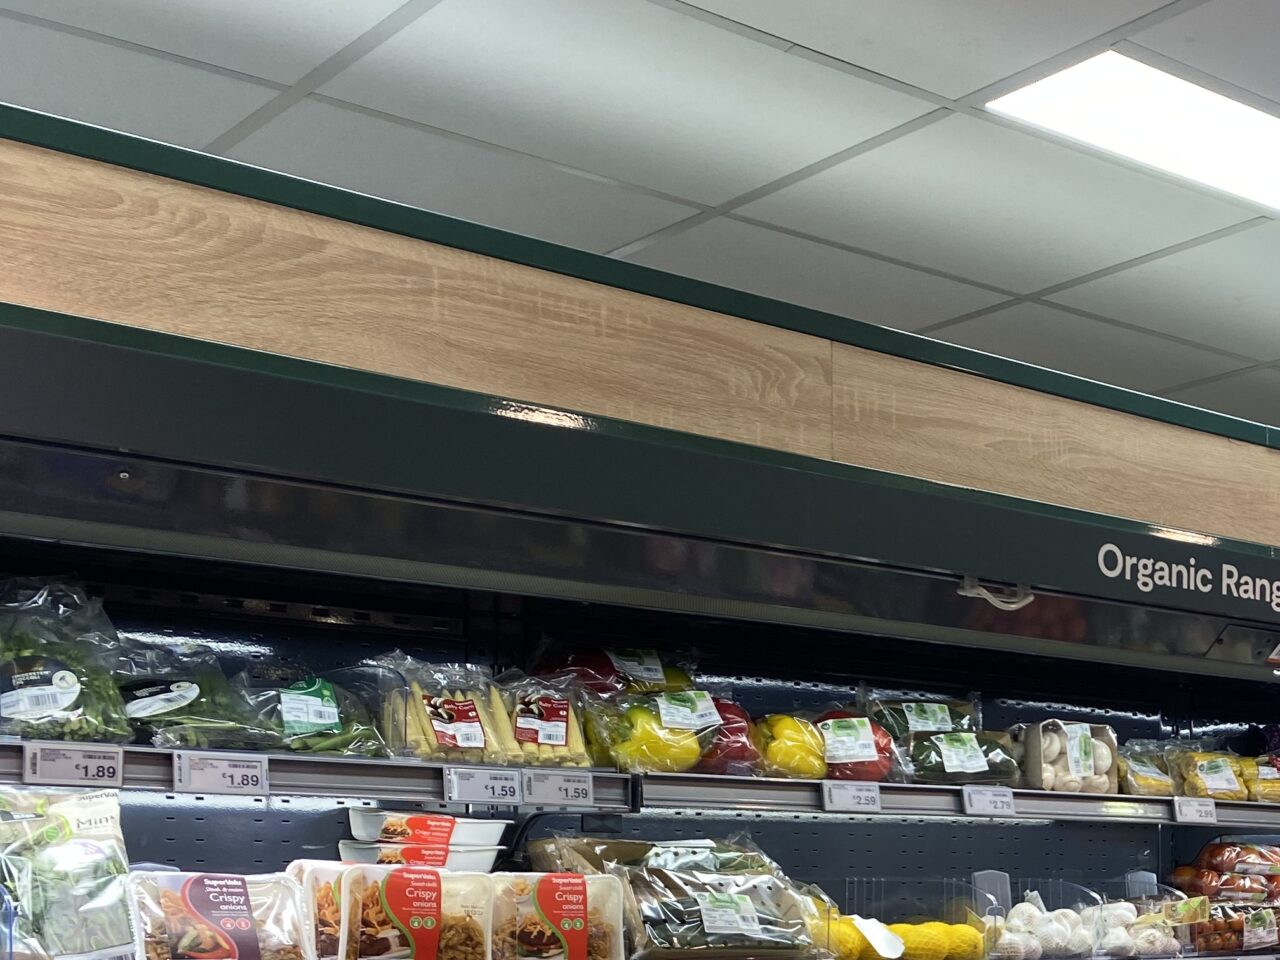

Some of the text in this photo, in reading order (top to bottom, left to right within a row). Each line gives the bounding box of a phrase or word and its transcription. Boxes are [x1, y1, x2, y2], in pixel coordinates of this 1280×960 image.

[1097, 543, 1213, 592] Organic
[74, 763, 116, 779] €1.89
[222, 772, 260, 787] €1.89
[484, 784, 516, 798] €1.59
[557, 786, 588, 799] €1.59
[852, 795, 876, 806] €2.59
[403, 872, 436, 880] SuperValu
[204, 878, 242, 887] SuperValu
[209, 893, 245, 904] Crispy
[405, 888, 437, 900] Crispy
[555, 892, 584, 903] Crispy
